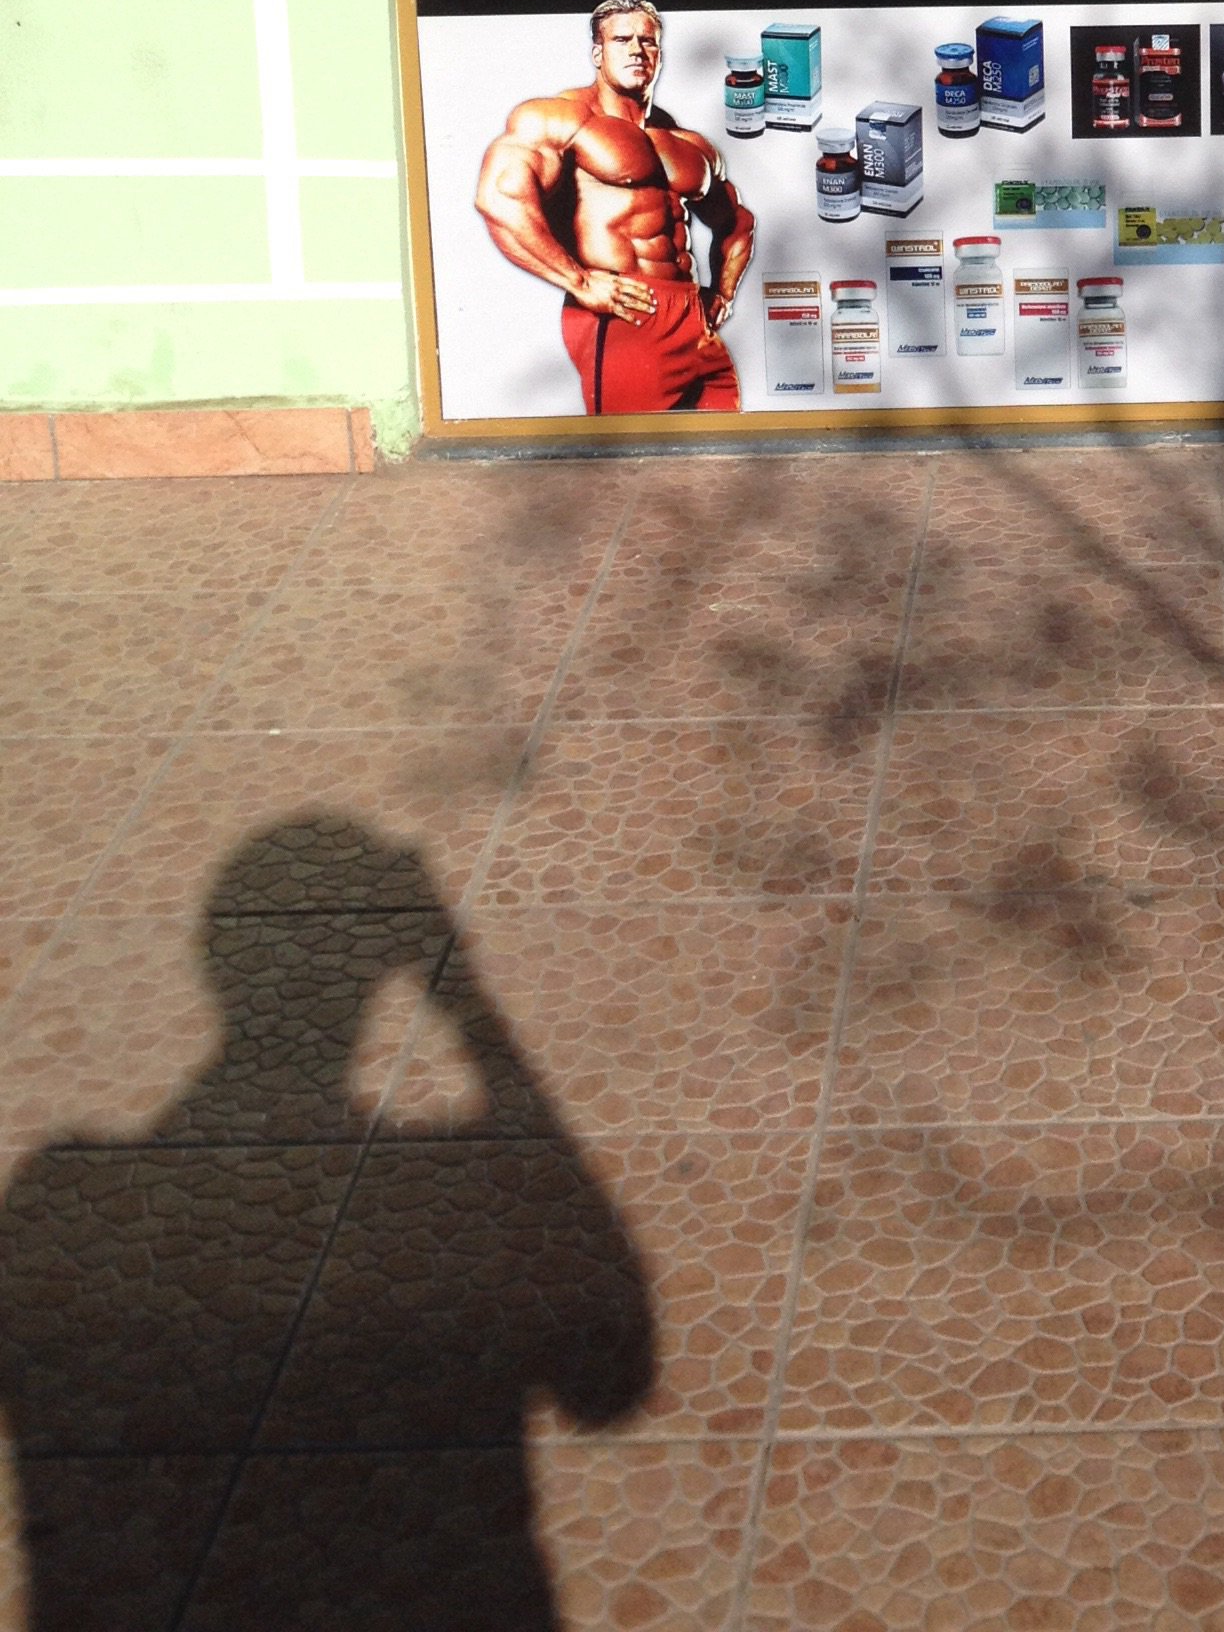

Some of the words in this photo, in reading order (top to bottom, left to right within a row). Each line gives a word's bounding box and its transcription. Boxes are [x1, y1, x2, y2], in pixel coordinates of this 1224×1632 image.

[767, 60, 778, 92] MAST
[983, 61, 993, 91] DECA
[992, 62, 1002, 93] M250
[863, 144, 874, 177] ENAN
[874, 148, 885, 178] M300
[823, 185, 843, 193] M300
